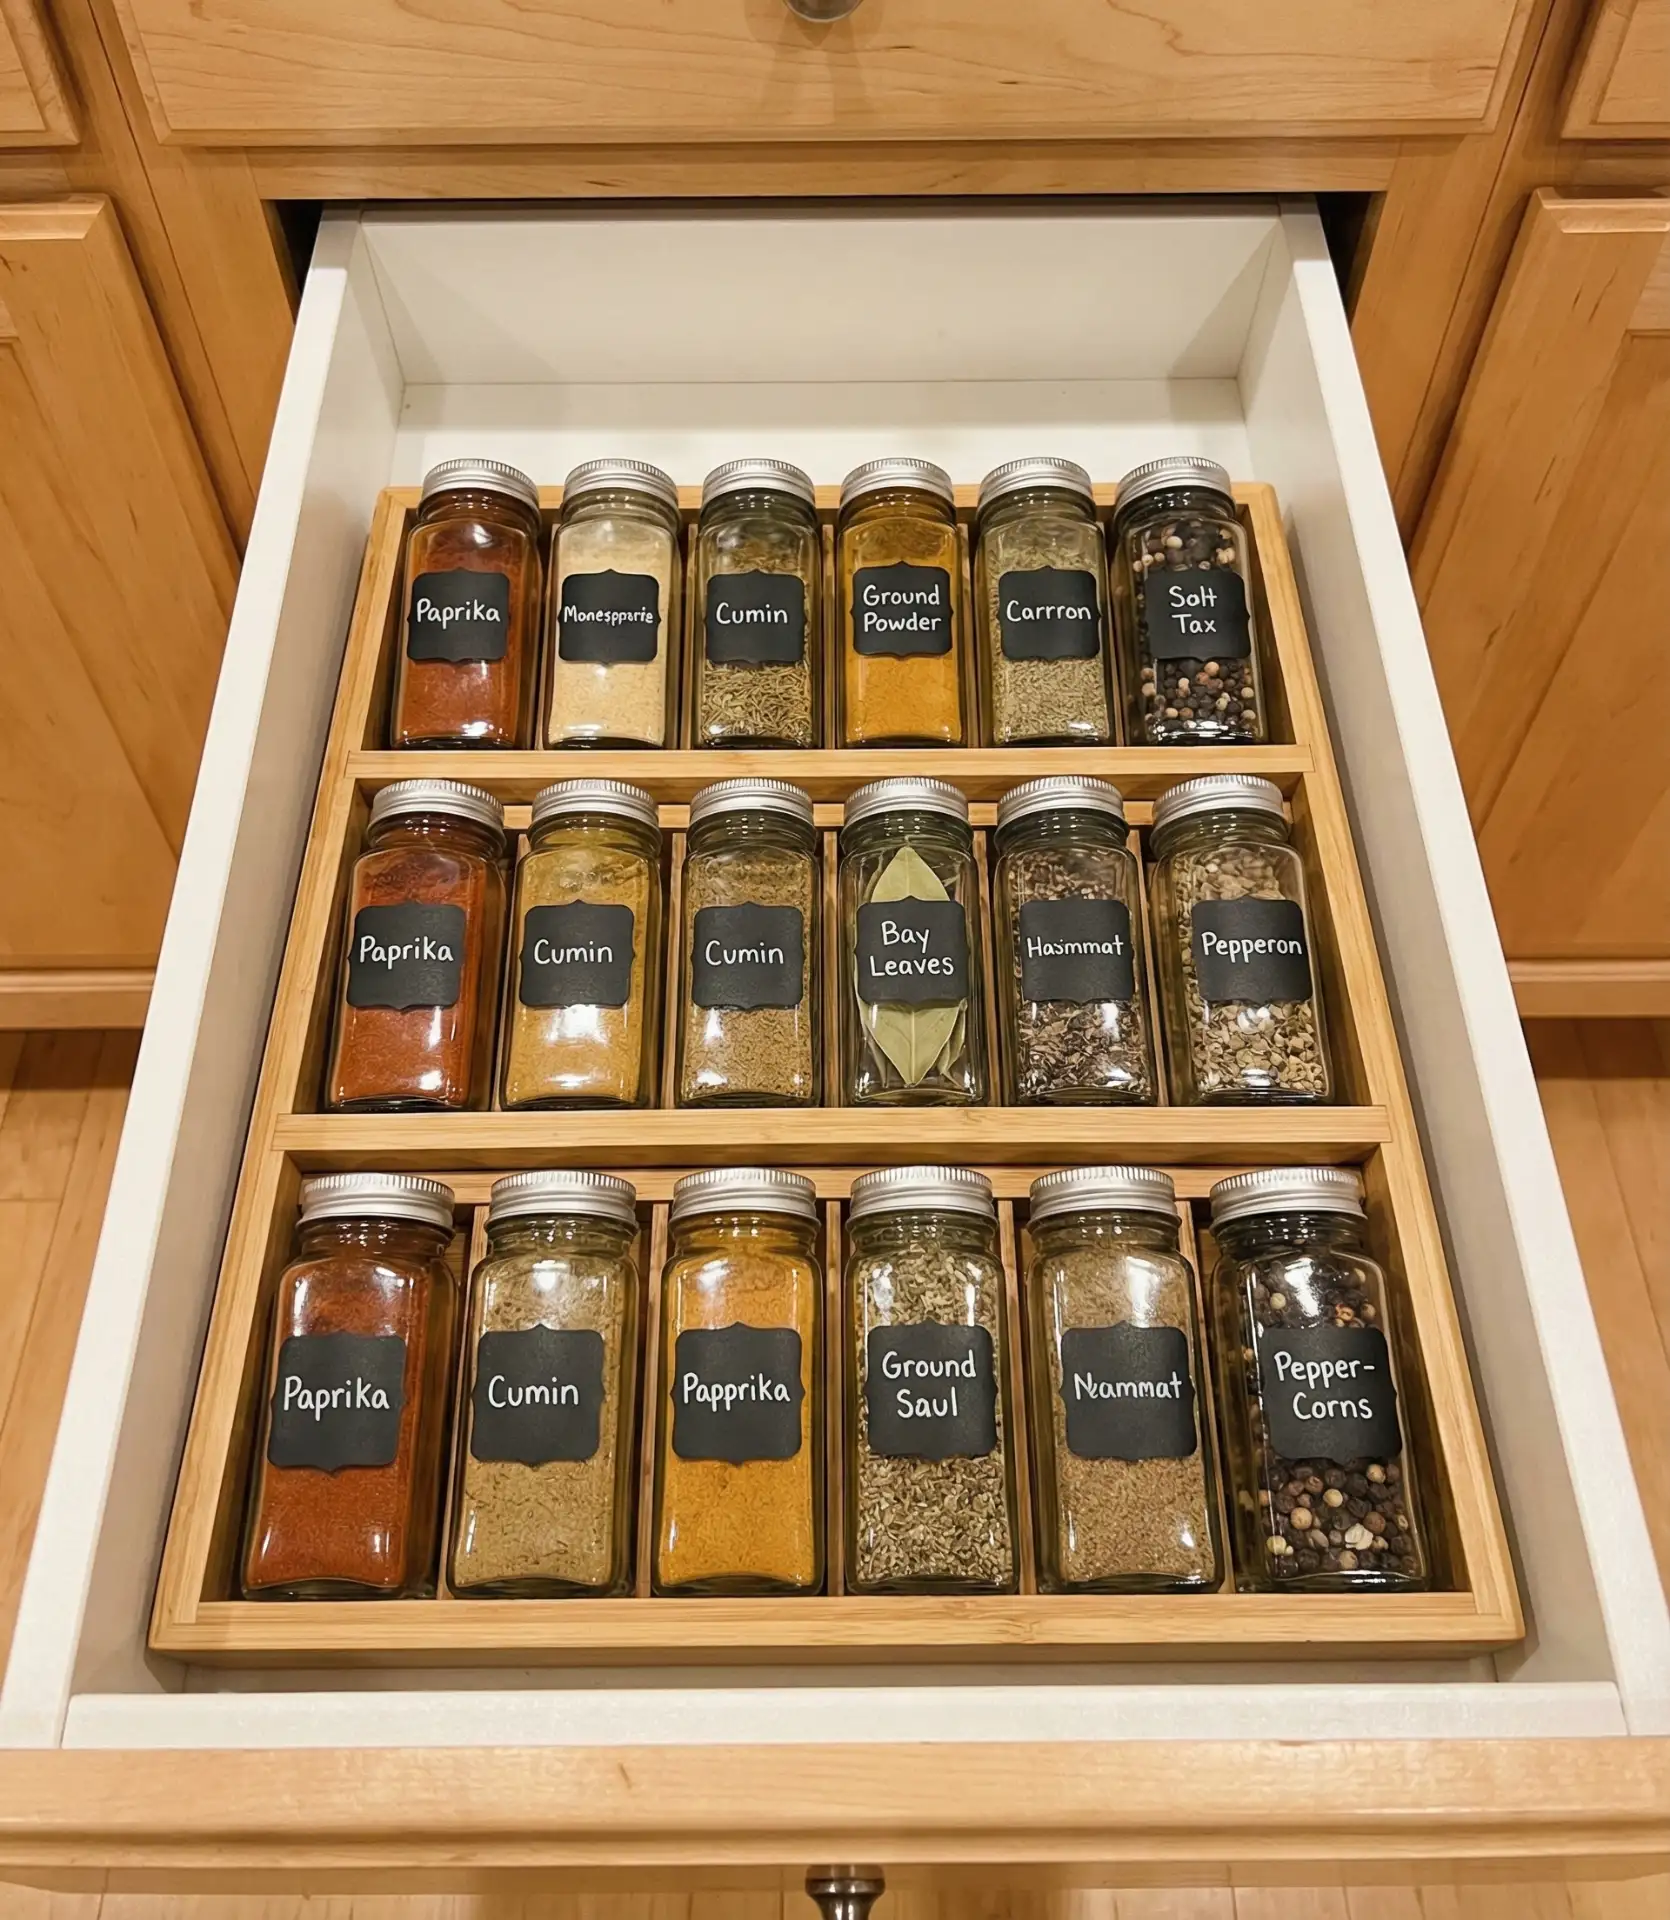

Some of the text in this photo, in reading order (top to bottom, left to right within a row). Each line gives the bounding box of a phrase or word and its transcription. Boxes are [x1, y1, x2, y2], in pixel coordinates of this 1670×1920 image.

[863, 583, 940, 607] Ground
[416, 597, 501, 630] Paprika
[716, 602, 788, 625] Cumin
[863, 611, 942, 633] Powder
[1006, 599, 1092, 622] Carrron
[1171, 613, 1217, 634] Tax
[534, 938, 613, 965] Cumin
[881, 920, 930, 953] Bay
[1201, 931, 1303, 963] Pepperon
[359, 935, 454, 970] Paprika
[705, 939, 784, 966] Cumin
[869, 954, 954, 977] Leaves
[882, 1349, 977, 1379] Ground
[1273, 1350, 1375, 1389] Pepper-
[283, 1375, 390, 1422] Paprika
[488, 1374, 579, 1408] Cumin
[683, 1372, 791, 1413] Papprika
[896, 1386, 958, 1419] Saul
[1292, 1391, 1373, 1420] Corns
